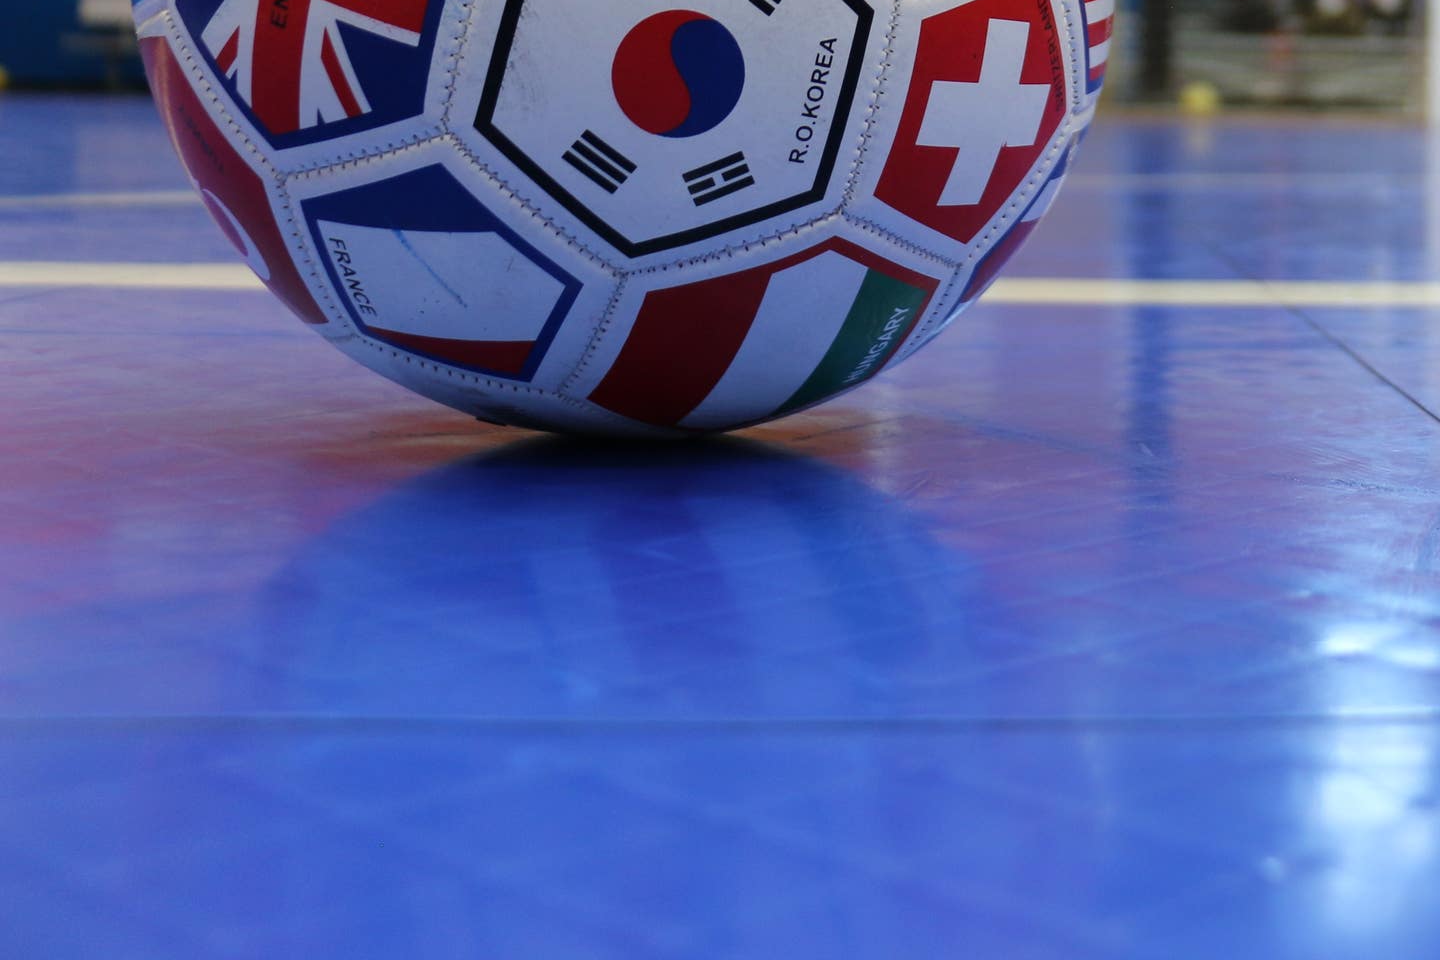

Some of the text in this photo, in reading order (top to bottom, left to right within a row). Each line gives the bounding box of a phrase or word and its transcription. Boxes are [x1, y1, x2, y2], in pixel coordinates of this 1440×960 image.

[788, 38, 838, 163] R.O.KOREA
[329, 237, 378, 317] FRANCE
[842, 307, 910, 383] HUNGARY
